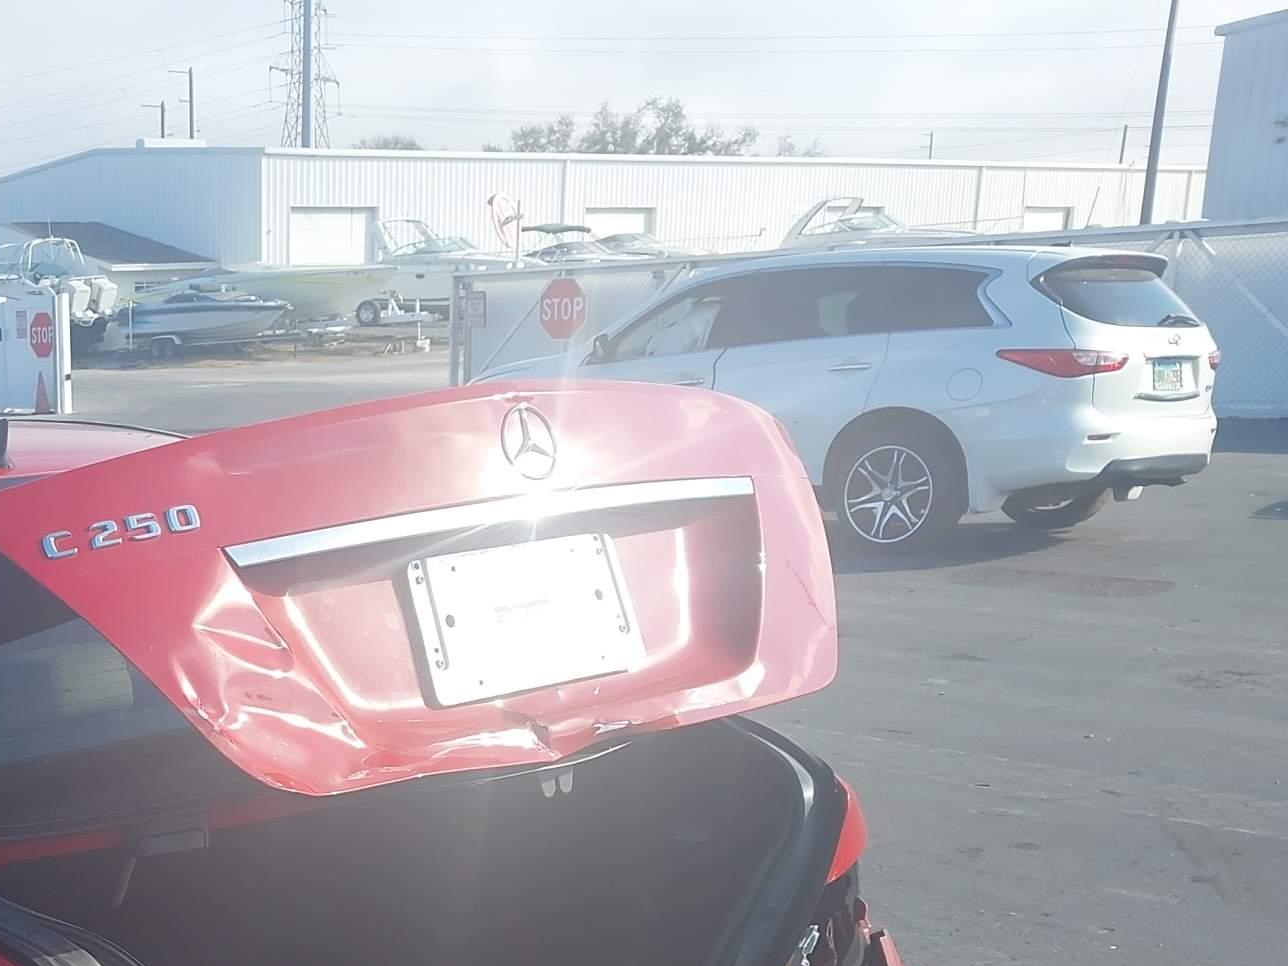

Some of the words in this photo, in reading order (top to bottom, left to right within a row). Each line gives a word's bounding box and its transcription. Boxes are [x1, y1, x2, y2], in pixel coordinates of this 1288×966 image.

[542, 297, 583, 320] STOP
[32, 326, 54, 343] STOP
[42, 530, 78, 560] C
[87, 504, 200, 550] 250
